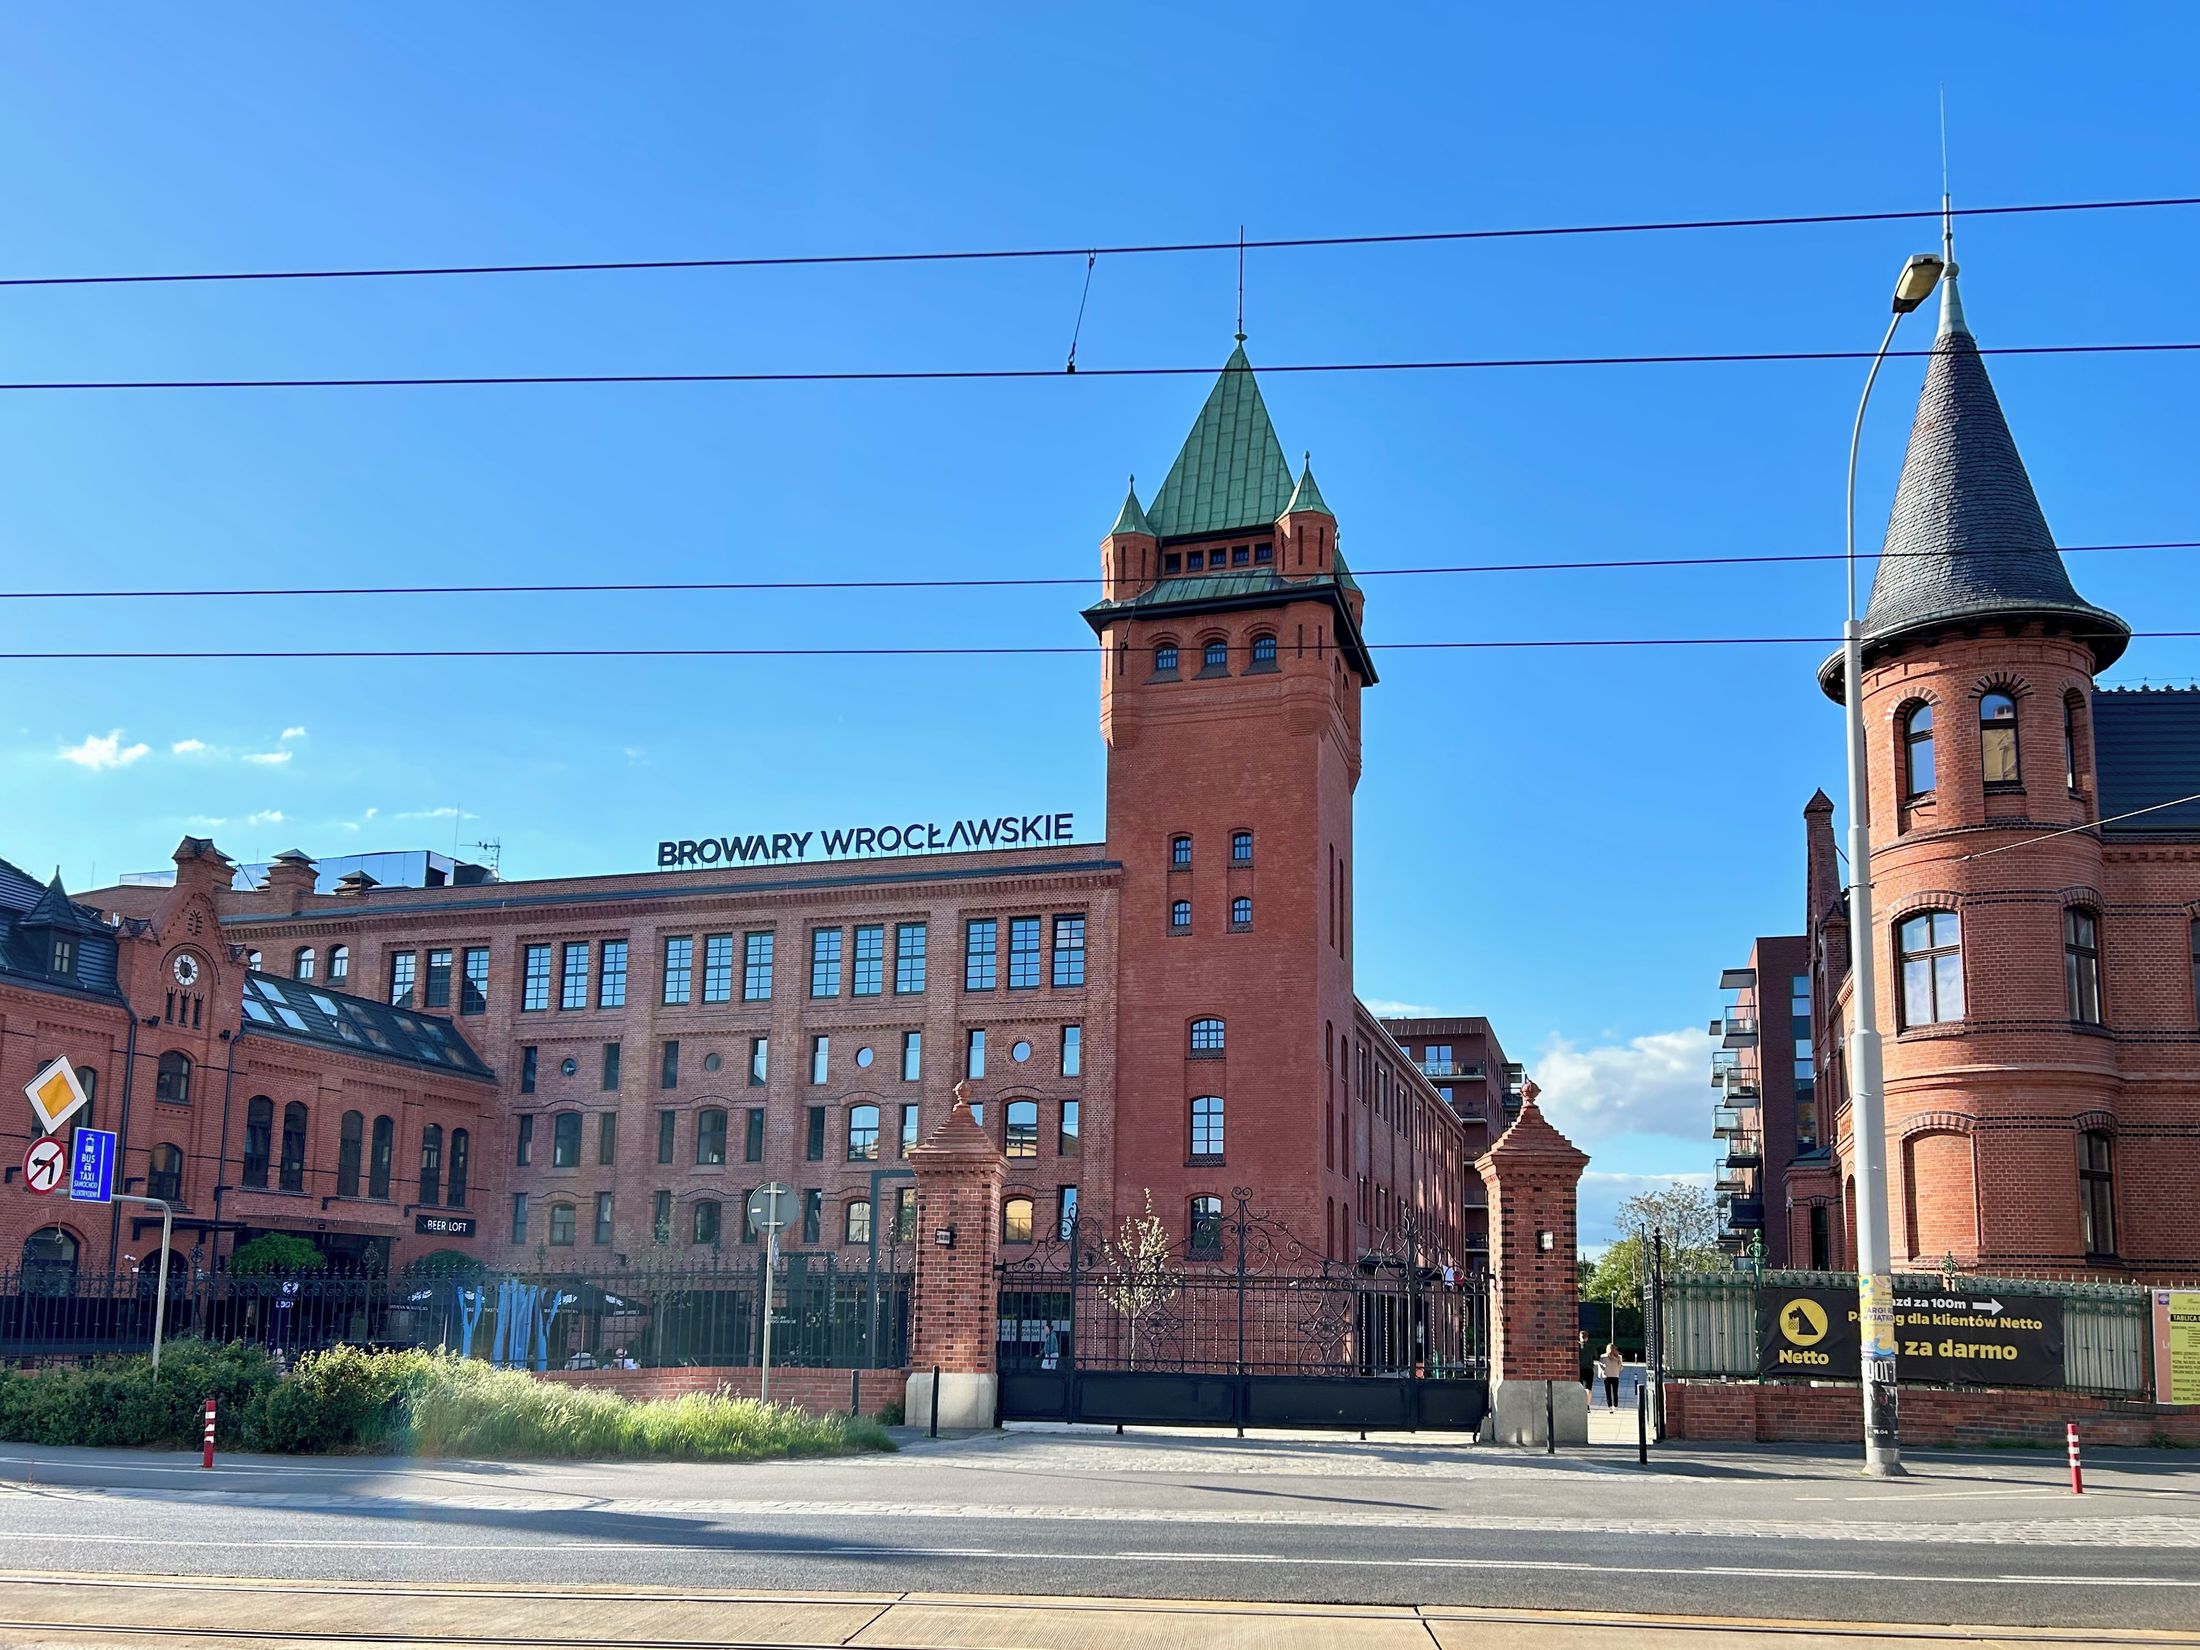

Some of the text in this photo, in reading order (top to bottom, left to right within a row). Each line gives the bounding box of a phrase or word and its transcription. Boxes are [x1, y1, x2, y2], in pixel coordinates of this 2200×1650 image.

[658, 813, 1074, 866] BROWARY WROCŁAWSKIE
[81, 1153, 96, 1163] BUS
[80, 1172, 95, 1181] TAXI
[428, 1220, 467, 1232] BEER LOFT
[1914, 1299, 1929, 1308] za
[1931, 1299, 1966, 1309] 100m
[1908, 1313, 1930, 1325] dla
[1933, 1314, 1997, 1328] klientów
[2001, 1317, 2043, 1330] Netto
[1905, 1341, 1932, 1356] za
[1939, 1339, 2018, 1360] darmo
[1779, 1349, 1829, 1365] Netto
